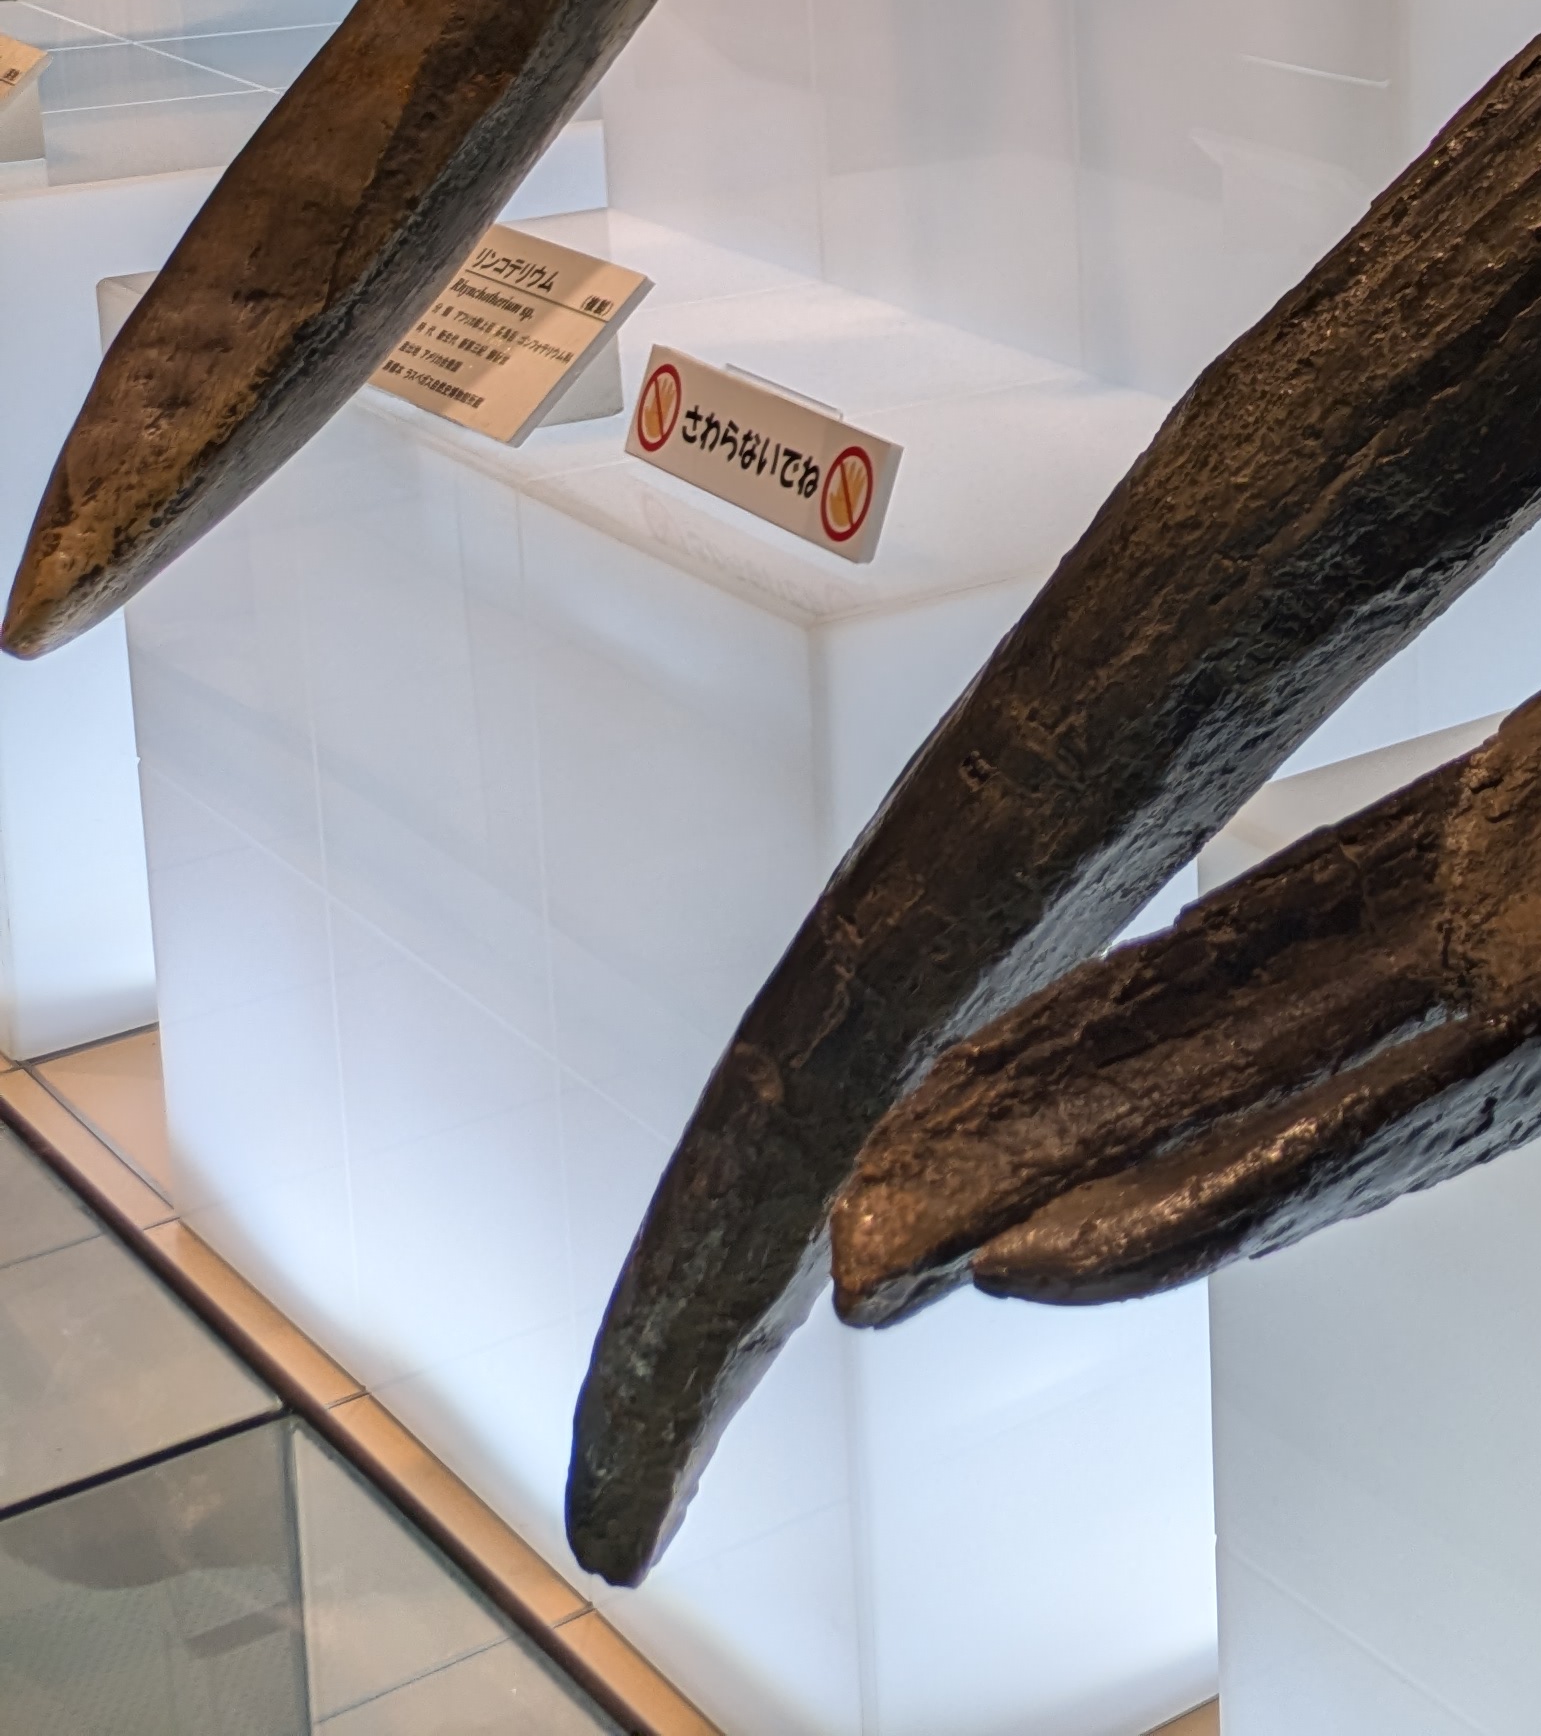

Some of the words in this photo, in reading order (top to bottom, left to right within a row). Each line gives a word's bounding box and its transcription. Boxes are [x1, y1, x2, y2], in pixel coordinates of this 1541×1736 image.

[473, 248, 559, 293] リンコテリウム
[450, 277, 523, 314] Rhynchotherium
[519, 305, 535, 322] sp.
[682, 405, 820, 499] さわらないでね
